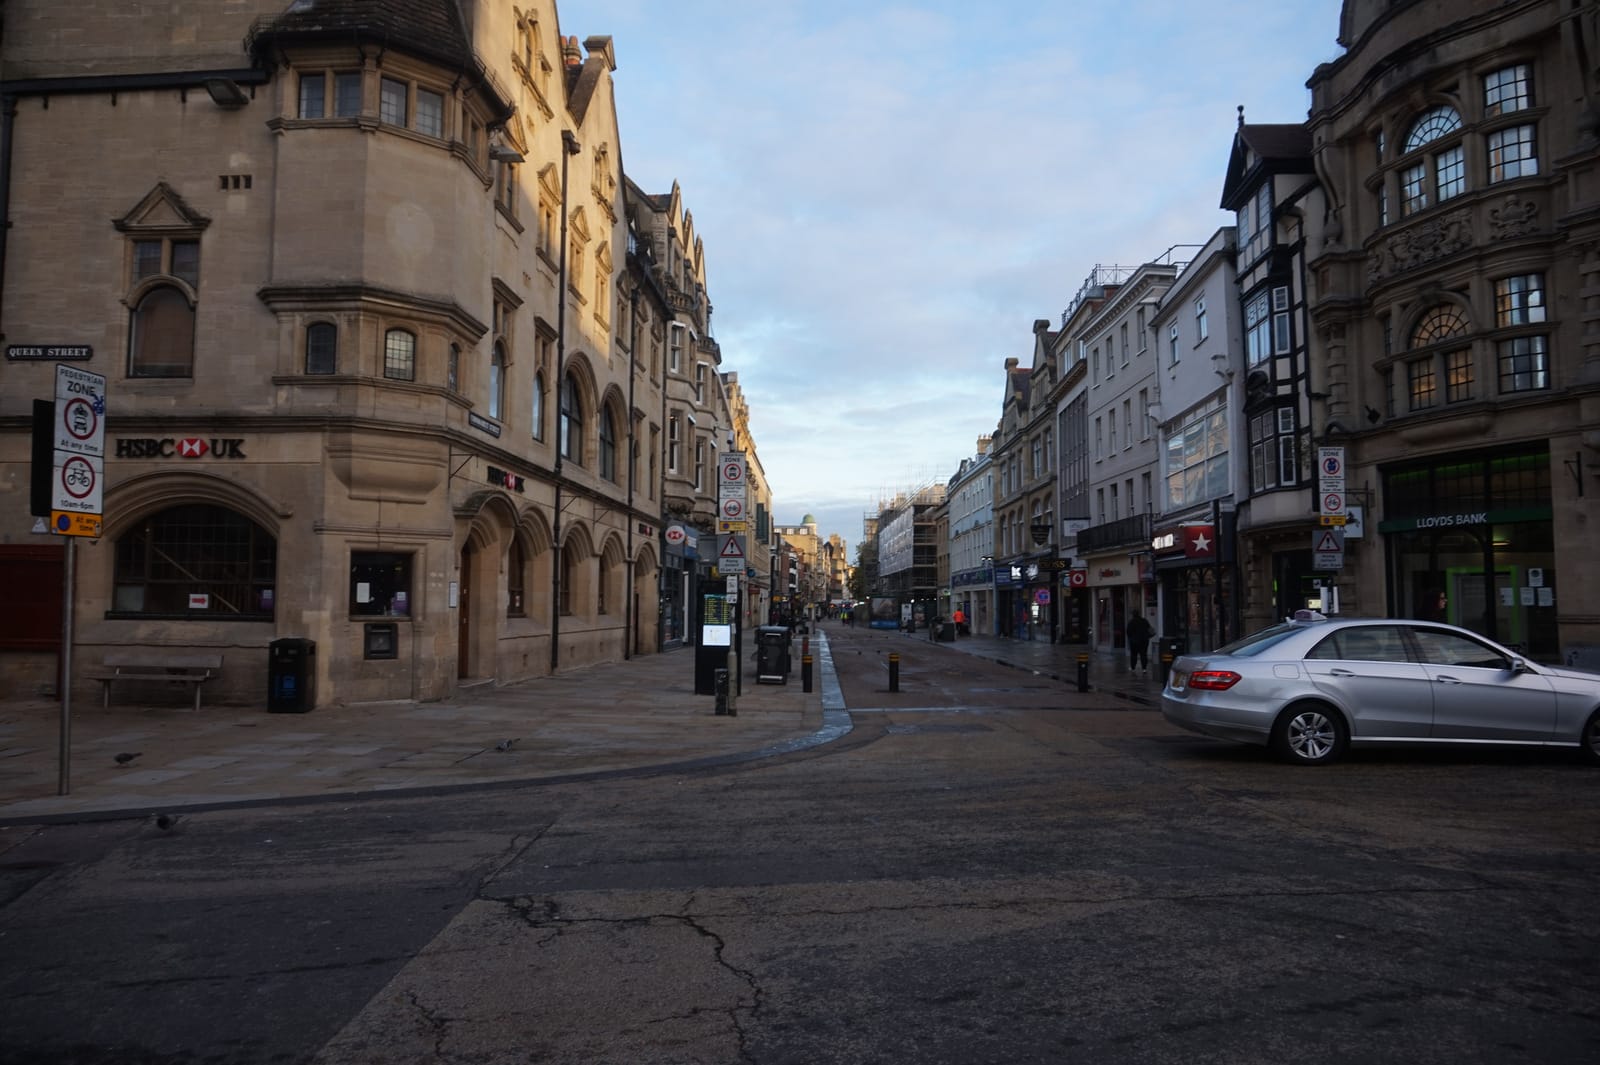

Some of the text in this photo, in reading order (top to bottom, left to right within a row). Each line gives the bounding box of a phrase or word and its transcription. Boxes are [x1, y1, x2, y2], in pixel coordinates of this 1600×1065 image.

[9, 347, 89, 358] QUEEN STREET
[60, 368, 104, 385] PEDESTRIAN
[67, 380, 96, 397] ZONE
[61, 439, 98, 452] At any time
[115, 438, 246, 458] HSBC UK
[1416, 512, 1488, 529] LLOYDS BANK
